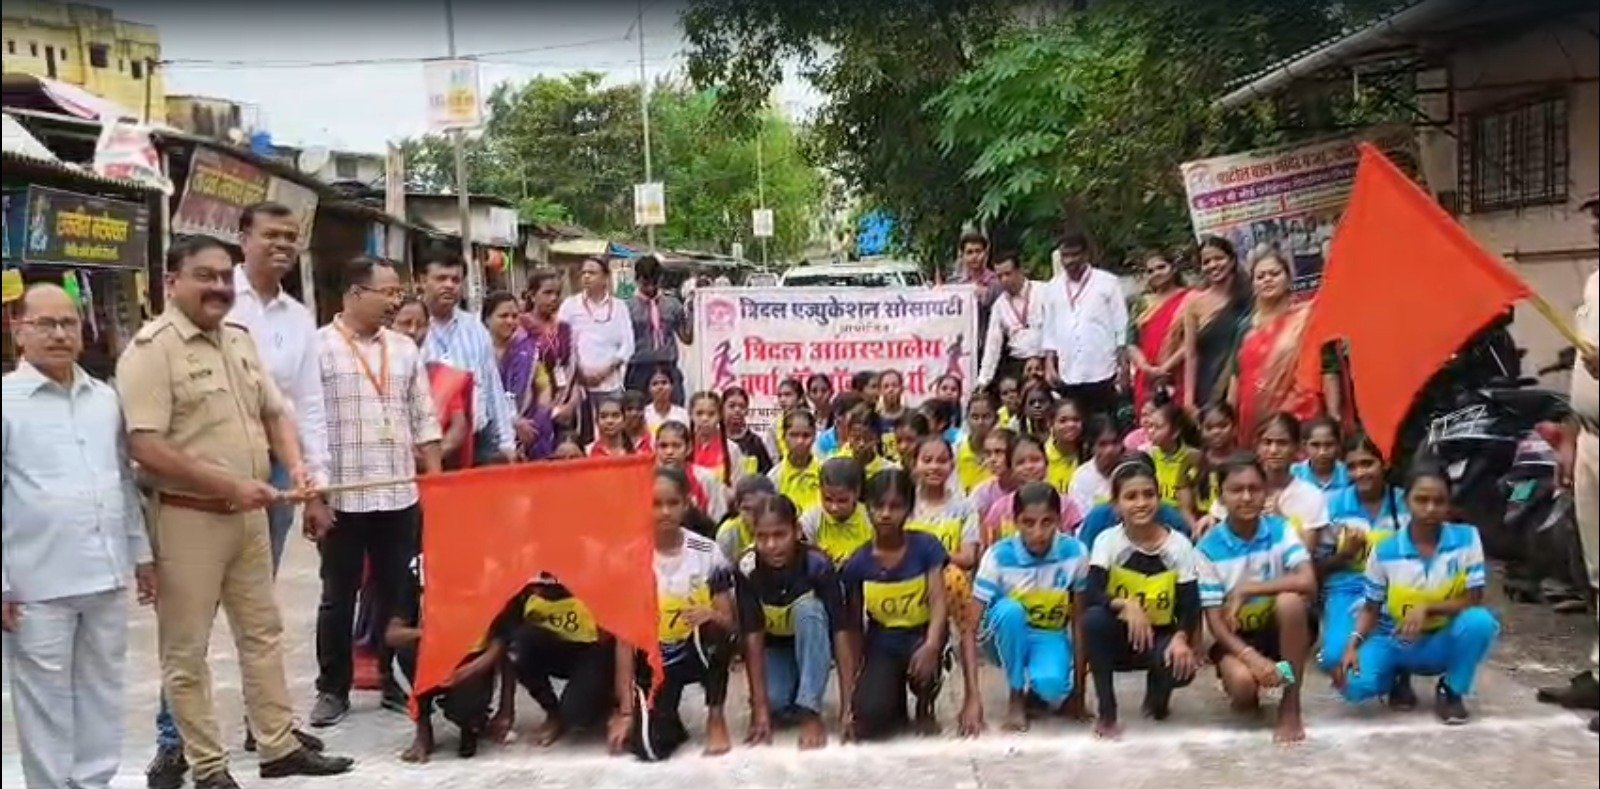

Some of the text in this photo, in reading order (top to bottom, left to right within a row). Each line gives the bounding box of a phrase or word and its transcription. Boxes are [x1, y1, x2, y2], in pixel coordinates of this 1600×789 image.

[739, 294, 963, 325] त्रिदल एज्युकेशन सोसायटी
[743, 335, 804, 361] त्रिदल
